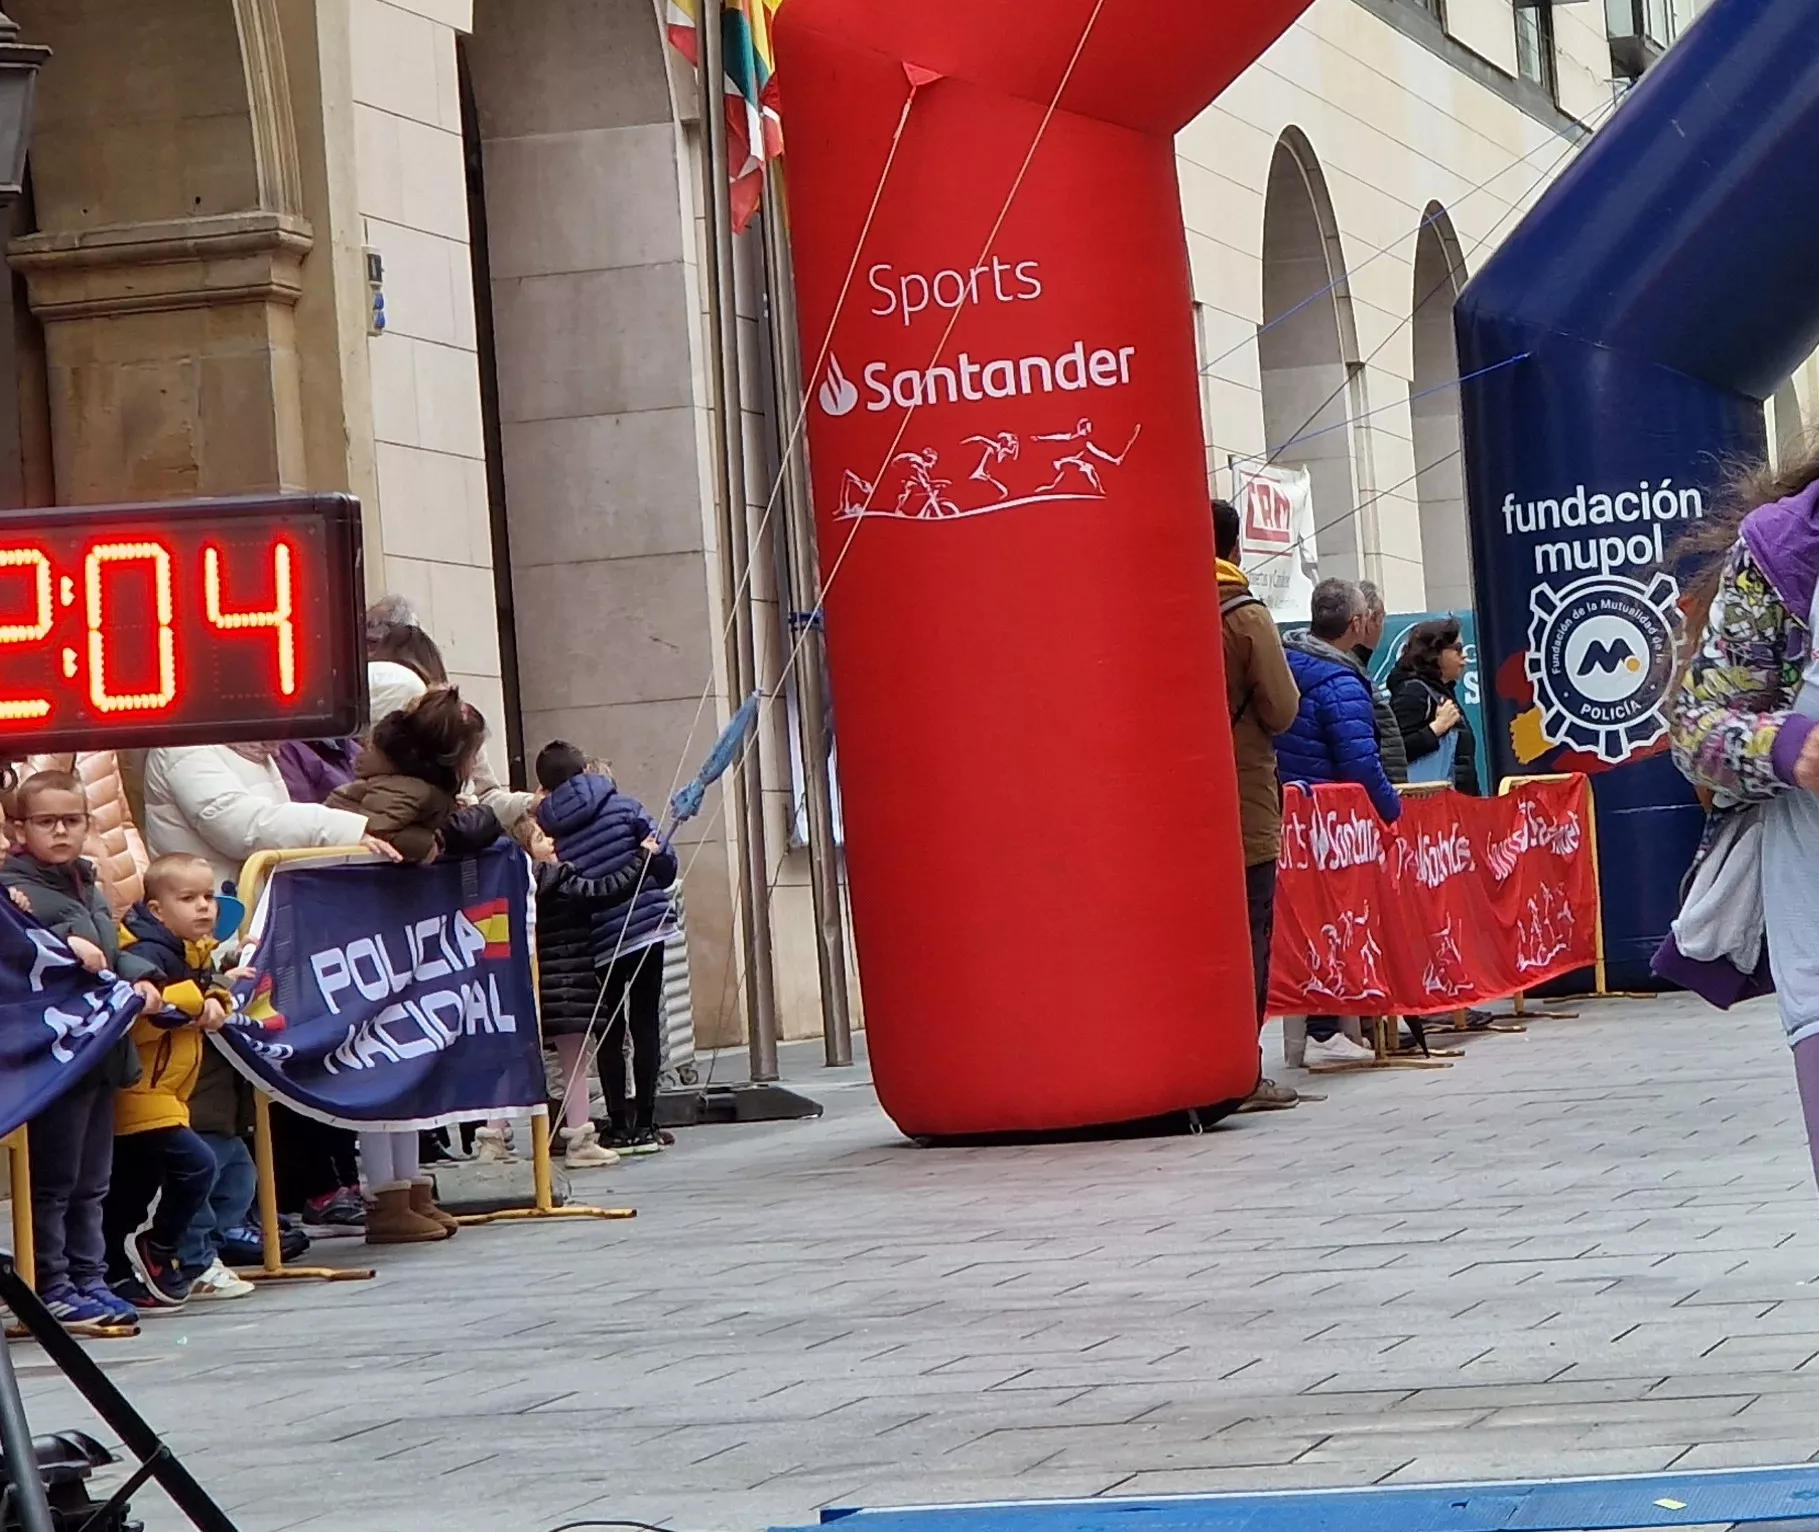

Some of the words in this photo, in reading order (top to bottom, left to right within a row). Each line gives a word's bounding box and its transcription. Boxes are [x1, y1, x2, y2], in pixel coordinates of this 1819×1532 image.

[869, 255, 1042, 327] Sports
[864, 340, 1136, 412] Santander
[1502, 478, 1704, 535] fundación
[1534, 522, 1664, 575] mupol
[1551, 619, 1574, 675] Fundación
[1572, 606, 1587, 620] de
[1587, 601, 1598, 613] la
[1600, 599, 1659, 635] Mutualidad
[1580, 700, 1642, 721] POLICÍA
